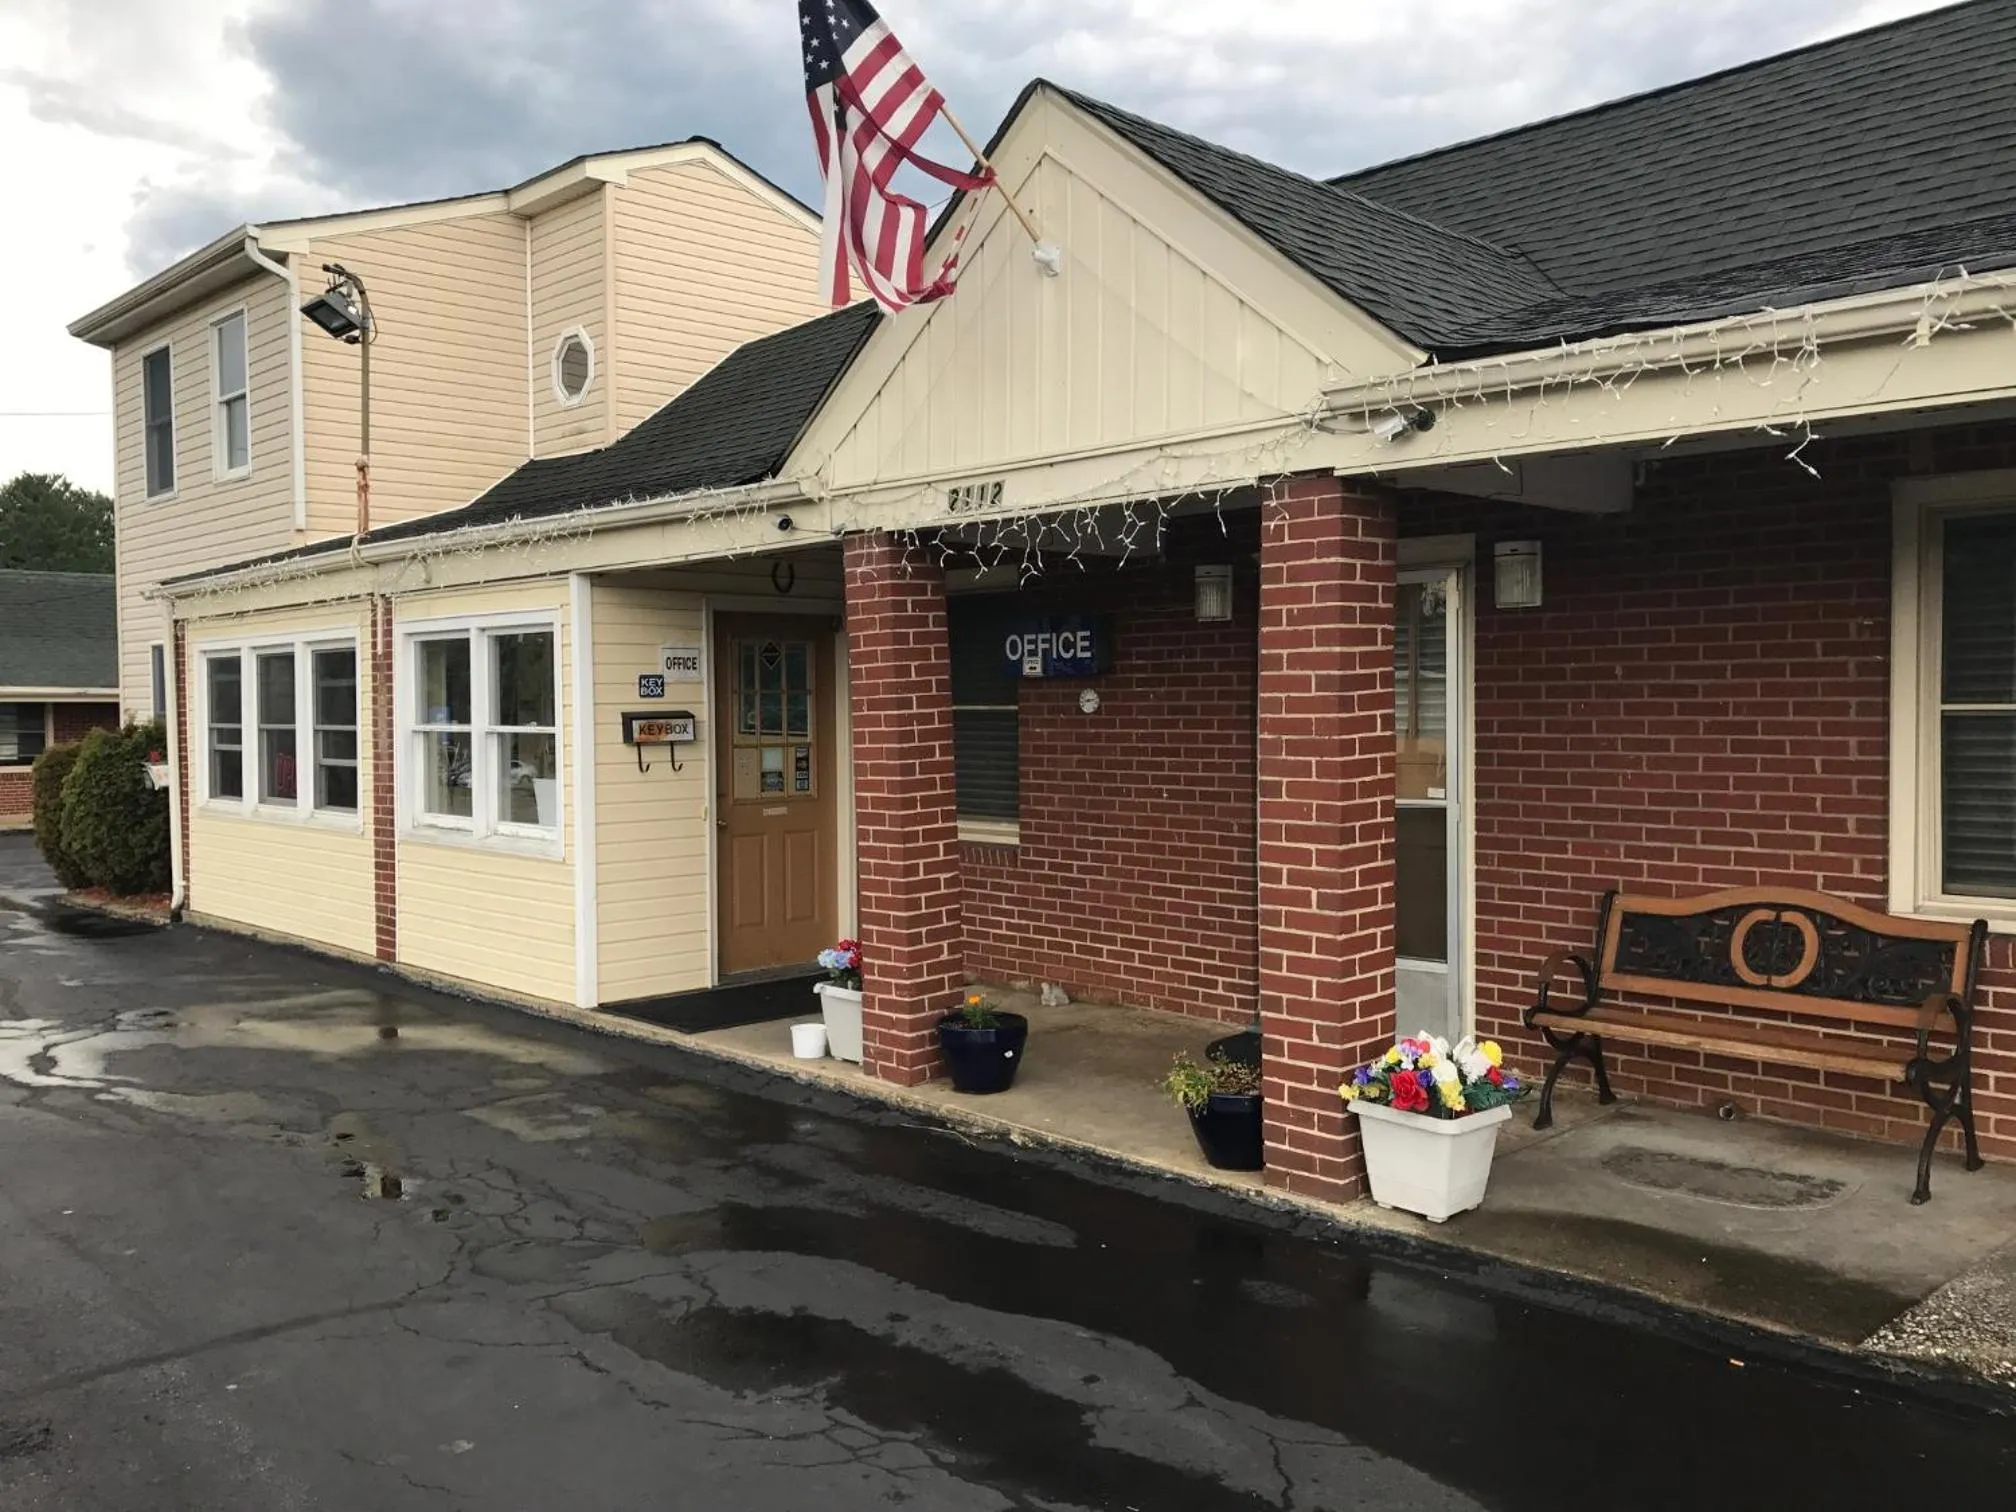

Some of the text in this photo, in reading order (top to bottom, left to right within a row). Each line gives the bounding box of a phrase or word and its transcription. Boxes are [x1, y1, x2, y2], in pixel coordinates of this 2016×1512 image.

[1005, 630, 1092, 661] OFFICE
[665, 656, 697, 670] OFFICE
[641, 678, 663, 687] KEY
[641, 686, 663, 695] BOX
